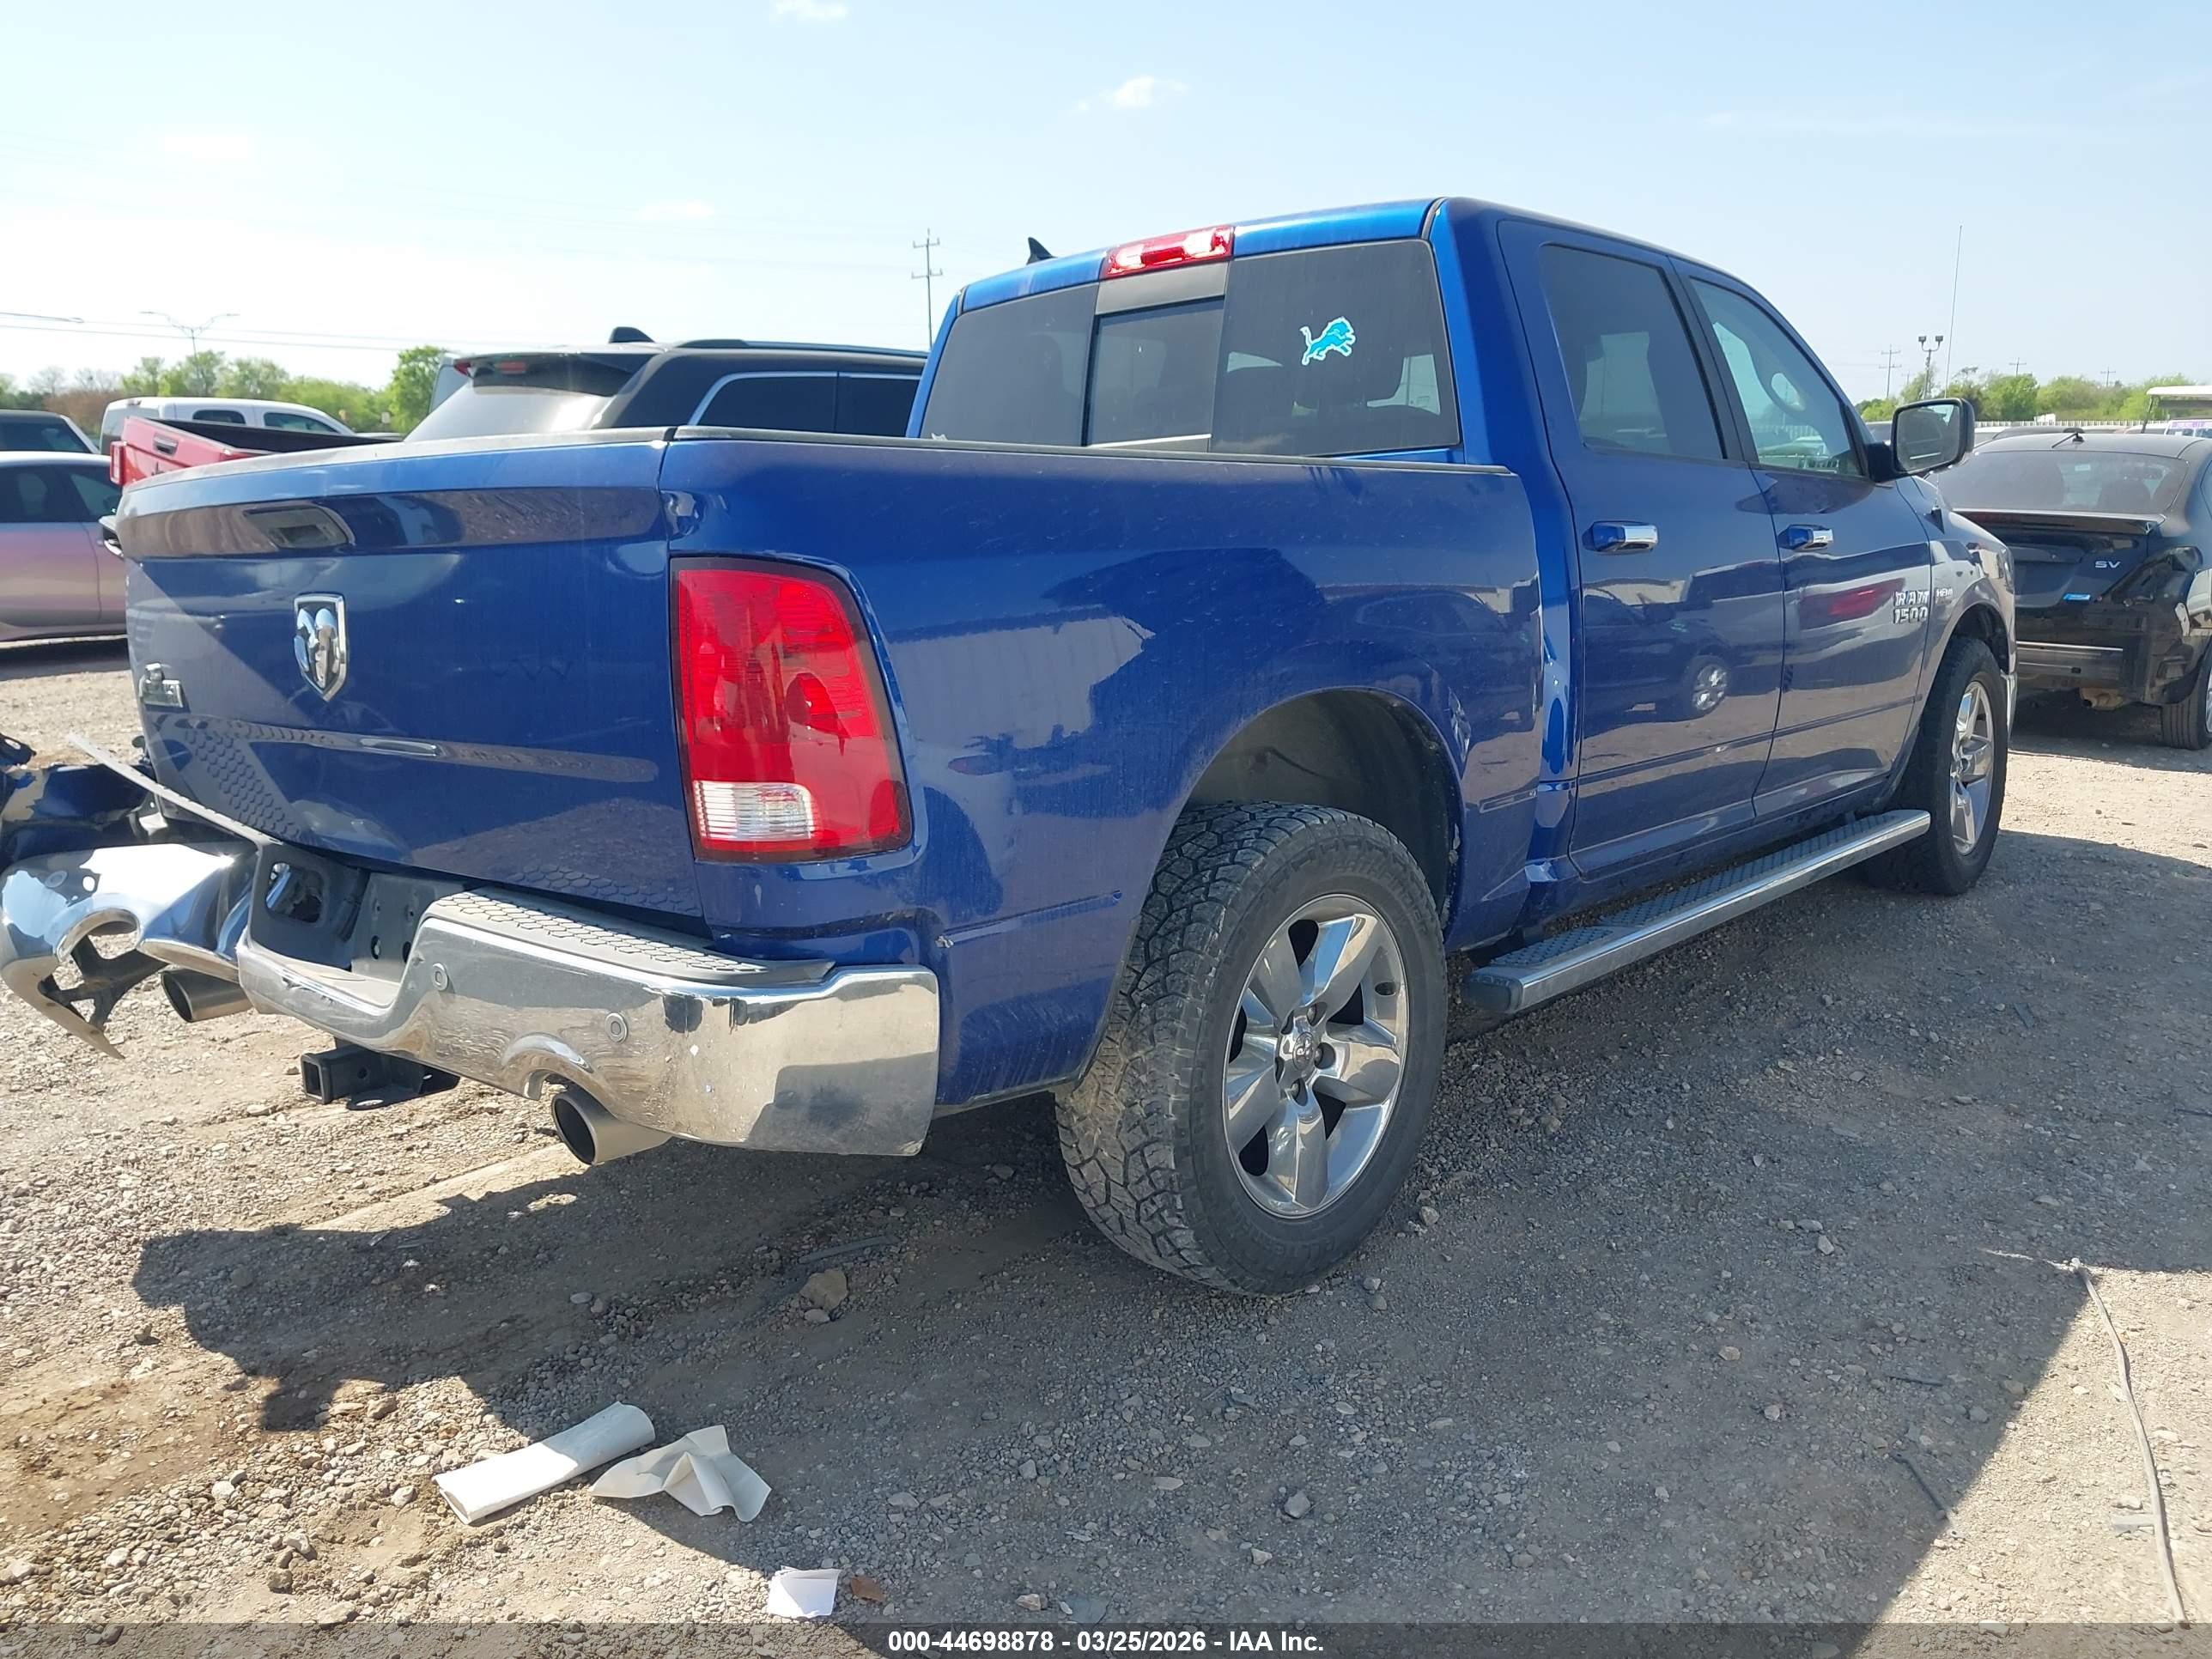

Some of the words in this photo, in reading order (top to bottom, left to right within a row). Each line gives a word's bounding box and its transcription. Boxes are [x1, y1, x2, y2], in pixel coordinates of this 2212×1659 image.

[2094, 560, 2121, 568] SV
[1894, 590, 1930, 606] RAM
[1893, 606, 1929, 624] 1500
